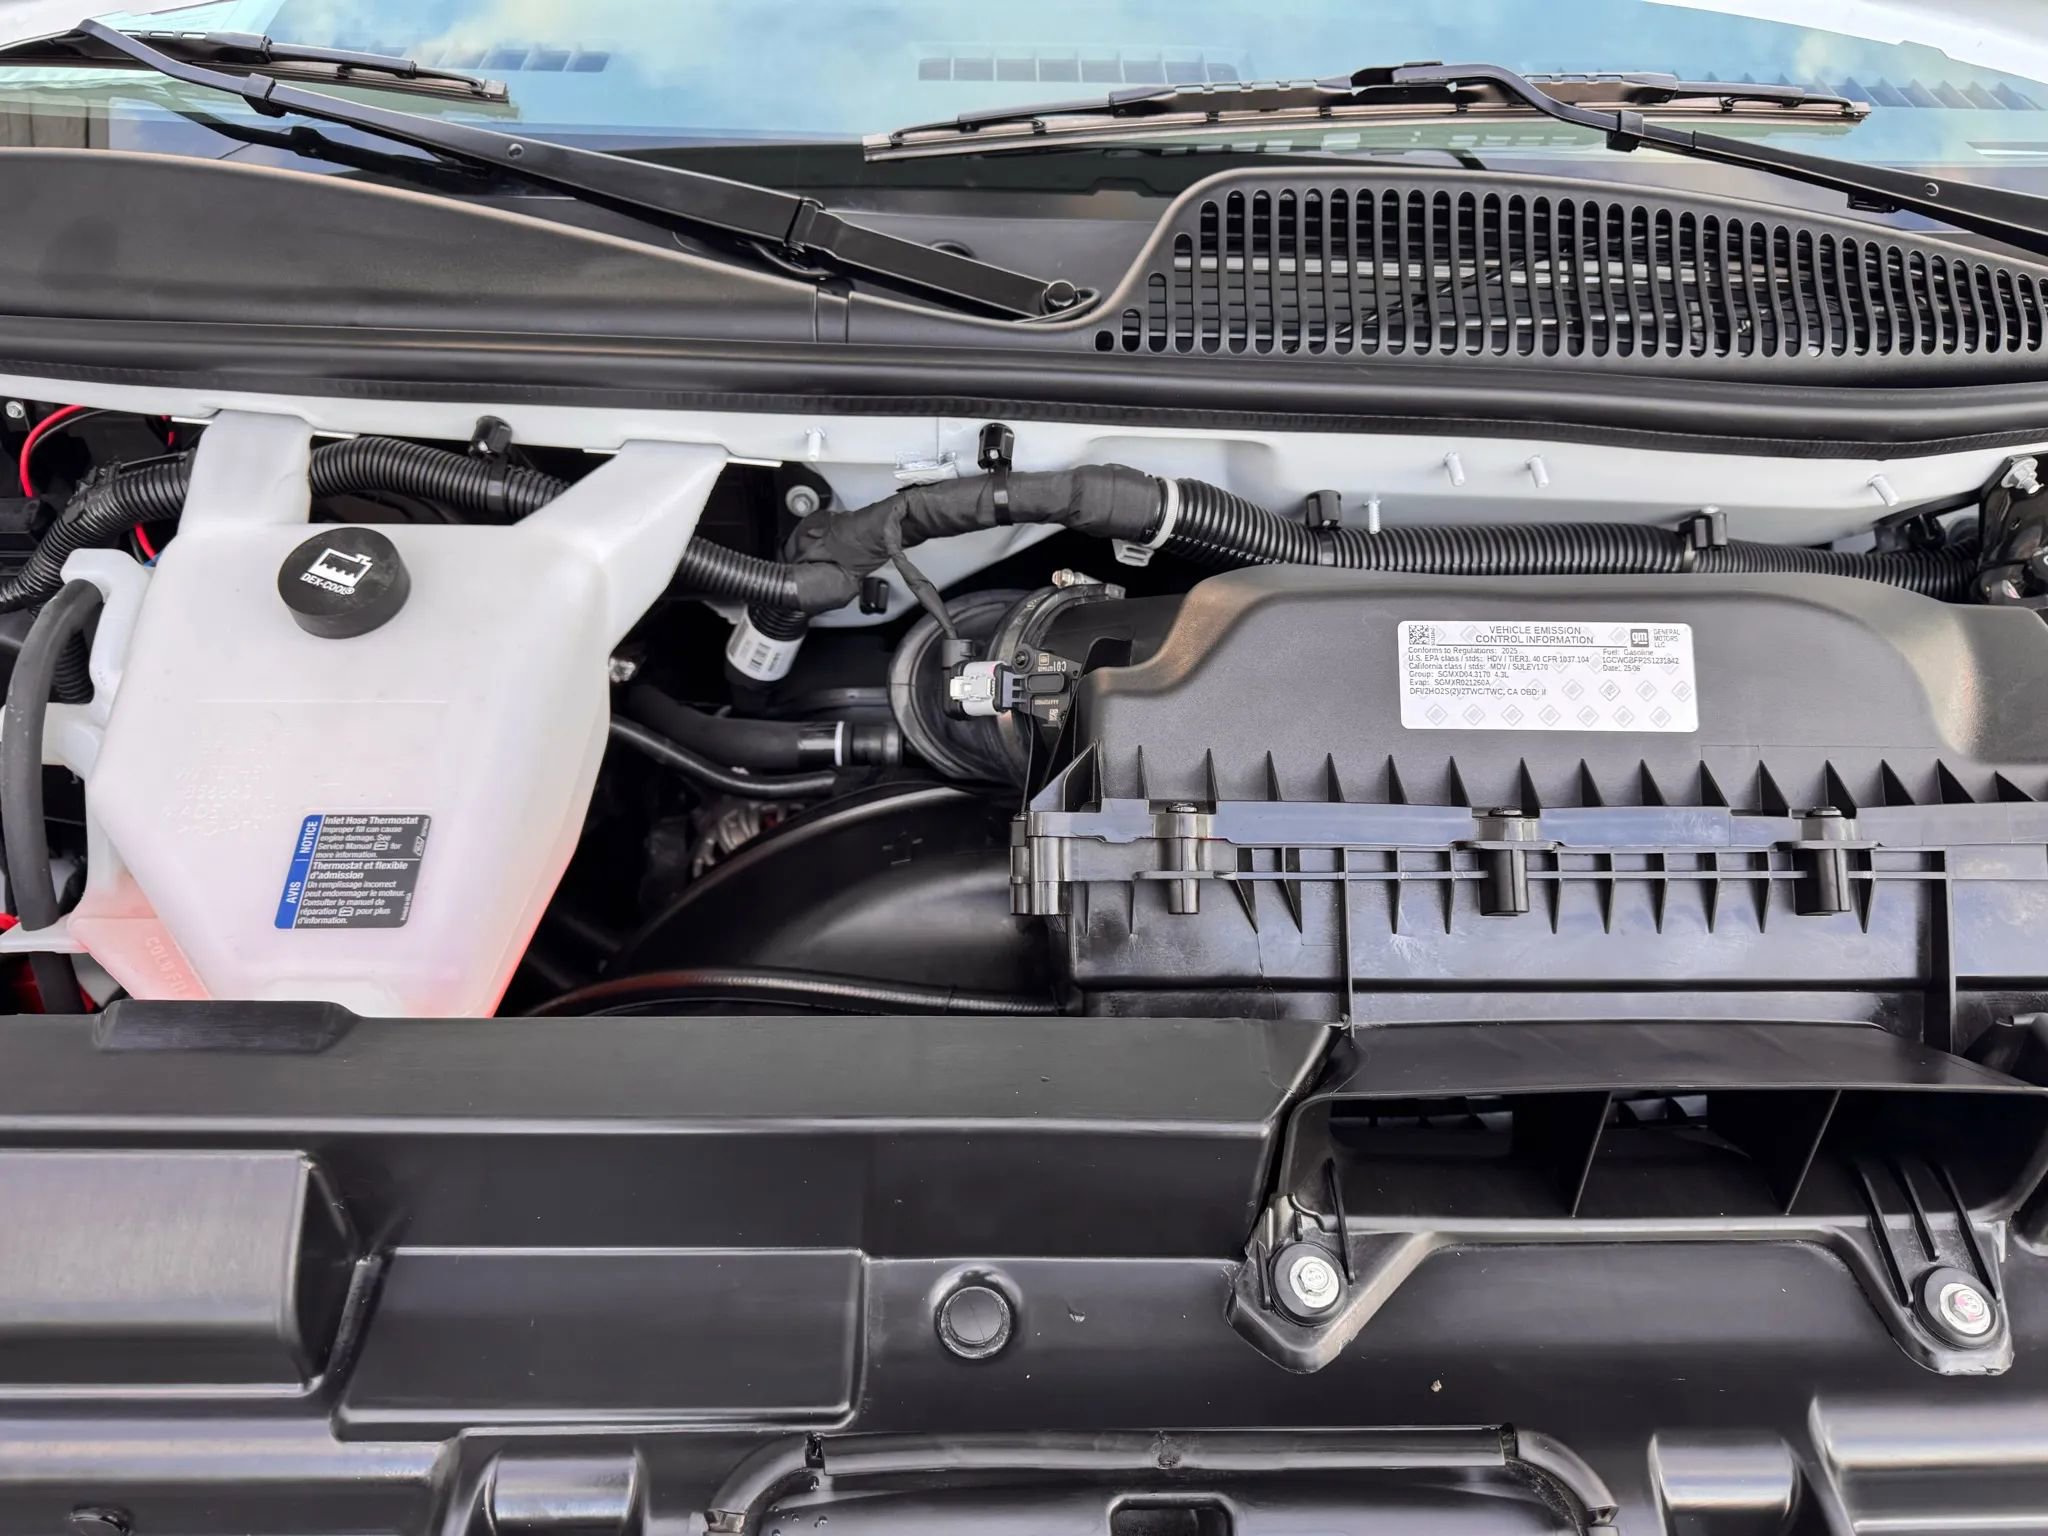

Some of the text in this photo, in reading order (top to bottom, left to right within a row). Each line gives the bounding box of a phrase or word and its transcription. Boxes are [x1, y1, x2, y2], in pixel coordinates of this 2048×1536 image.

[1489, 626, 1581, 635] VEHICLE EMISSION
[1476, 635, 1594, 644] CONTROL INFORMATION
[1632, 632, 1648, 644] gm
[1453, 647, 1496, 655] Regulations:
[1409, 671, 1434, 679] Group:
[1410, 679, 1430, 687] Evap:
[299, 821, 318, 853] NOTICE
[319, 881, 362, 889] remplissage
[287, 882, 301, 903] AVIS
[322, 890, 368, 898] endommager
